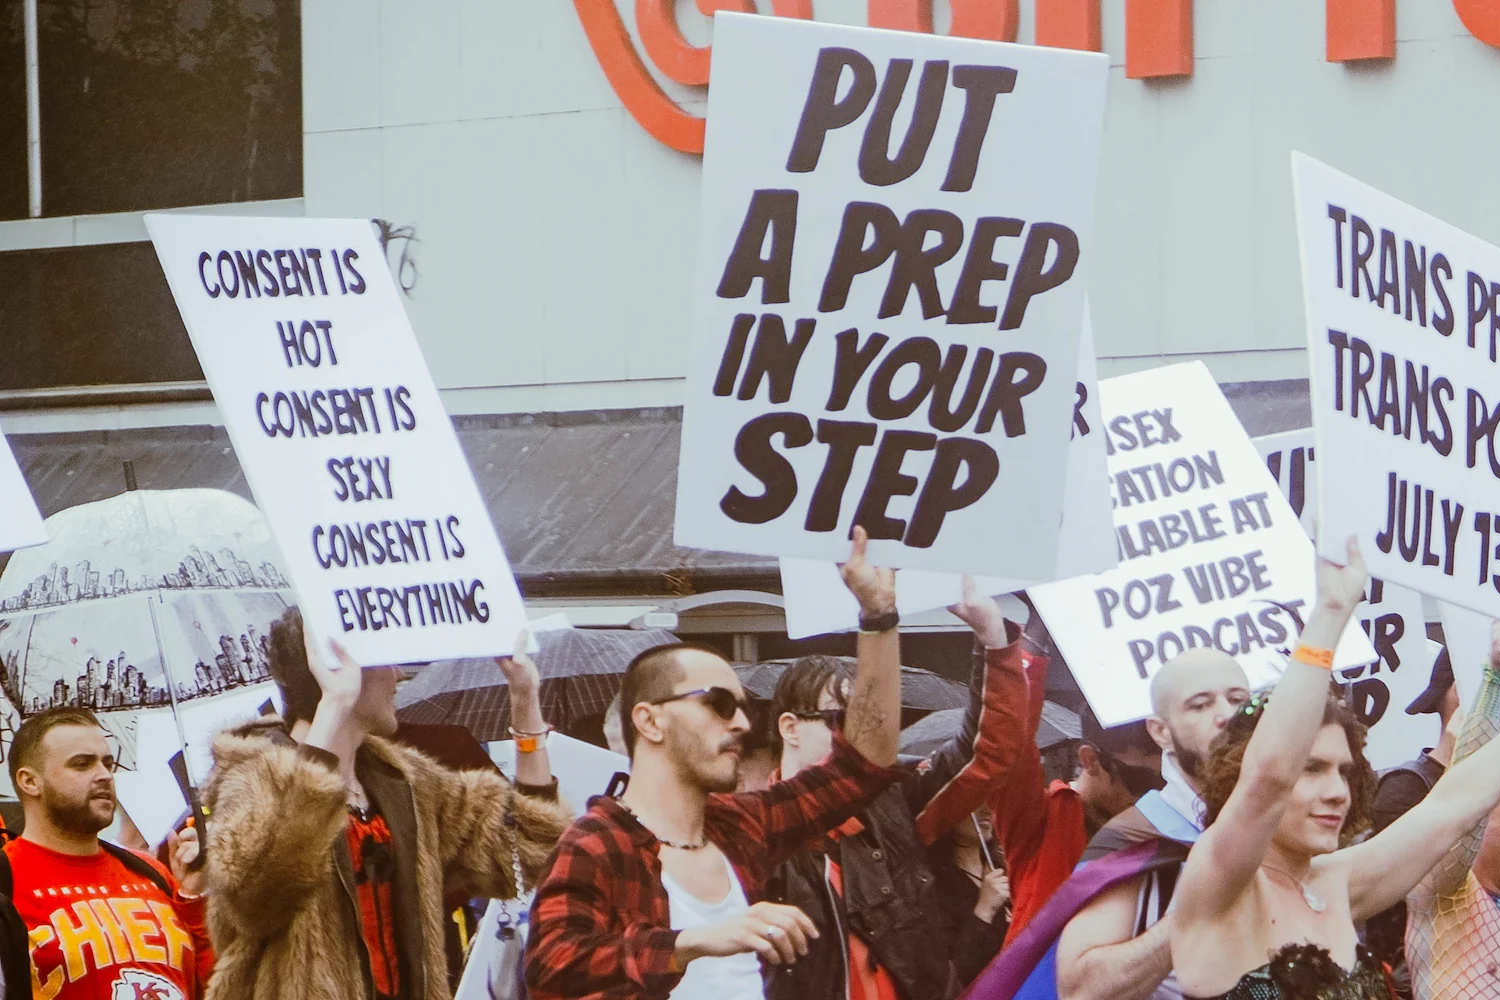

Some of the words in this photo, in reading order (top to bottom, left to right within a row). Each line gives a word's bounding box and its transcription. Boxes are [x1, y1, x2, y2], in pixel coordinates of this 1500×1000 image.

[786, 48, 1018, 192] PUT
[198, 248, 329, 298] CONSENT
[331, 248, 366, 295] IS
[716, 189, 799, 304] A
[818, 201, 1080, 330] PREP
[1328, 203, 1454, 336] TRANS
[276, 320, 338, 367] HOT
[713, 313, 817, 403] IN
[825, 328, 1046, 438] YOUR
[255, 387, 382, 437] CONSENT
[384, 385, 416, 430] IS
[1328, 329, 1454, 457] TRANS
[326, 457, 391, 502] SEXY
[720, 412, 999, 548] STEP
[1109, 450, 1225, 510] ATION
[1229, 492, 1274, 534] AT
[312, 517, 431, 568] CONSENT
[436, 516, 465, 558] IS
[1375, 472, 1464, 576] JULY
[335, 579, 489, 633] EVERYTHING
[1095, 573, 1182, 628] POZ
[1182, 549, 1272, 604] VIBE
[1128, 598, 1306, 678] PODCAST
